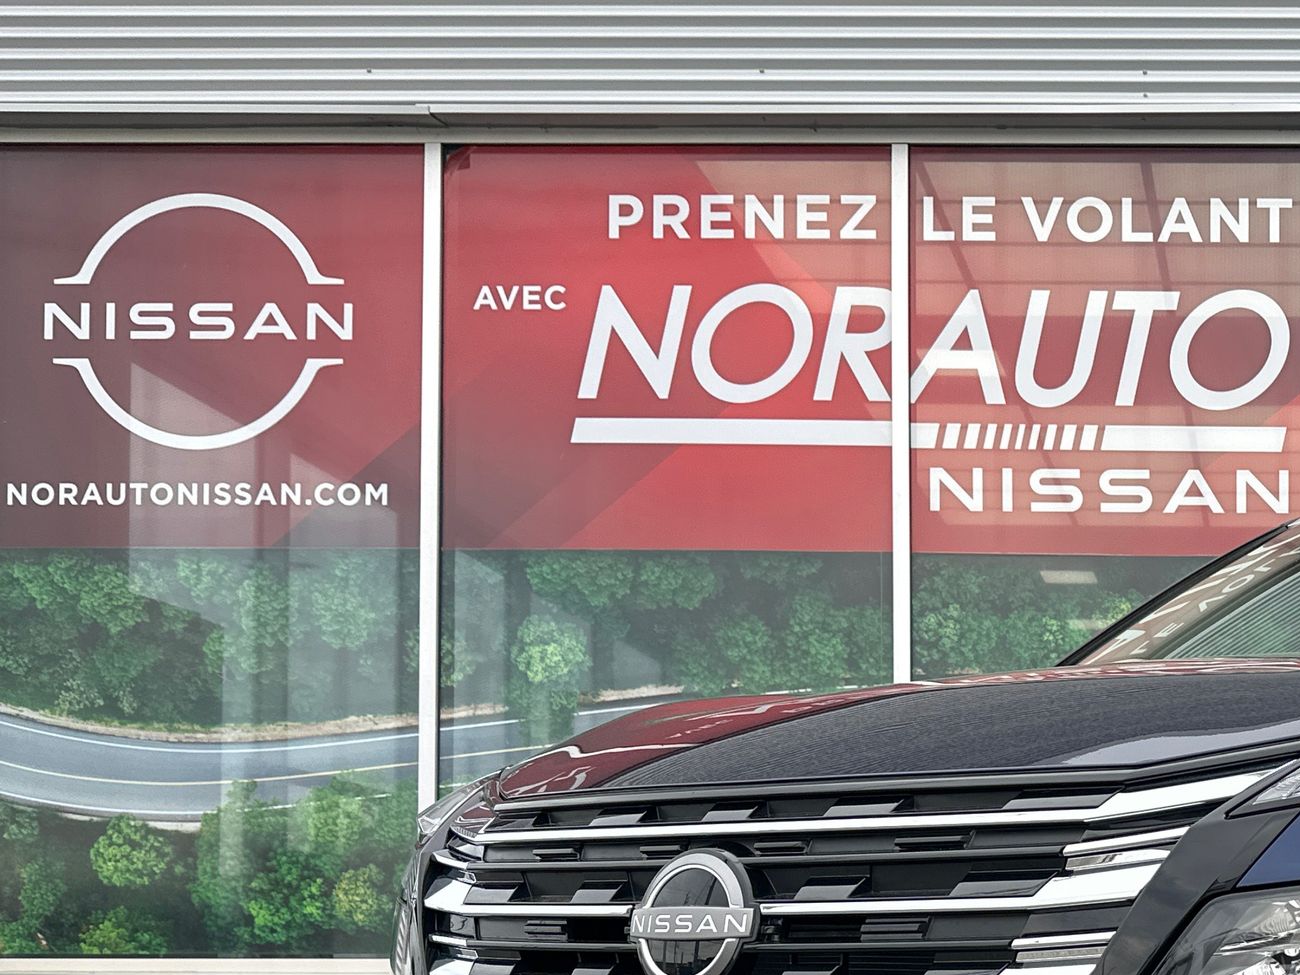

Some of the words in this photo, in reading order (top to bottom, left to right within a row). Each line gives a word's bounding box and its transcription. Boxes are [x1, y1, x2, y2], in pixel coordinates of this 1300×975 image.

[608, 194, 877, 240] PRENEZ
[923, 196, 996, 242] LE
[1020, 196, 1293, 243] VOLANT
[43, 302, 353, 340] NISSAN
[473, 285, 566, 310] AVEC
[576, 283, 1291, 411] NORAUTO
[7, 482, 388, 506] NORAUTONISSAN.COM
[929, 467, 1289, 514] NISSAN
[631, 913, 748, 933] NISSAN
